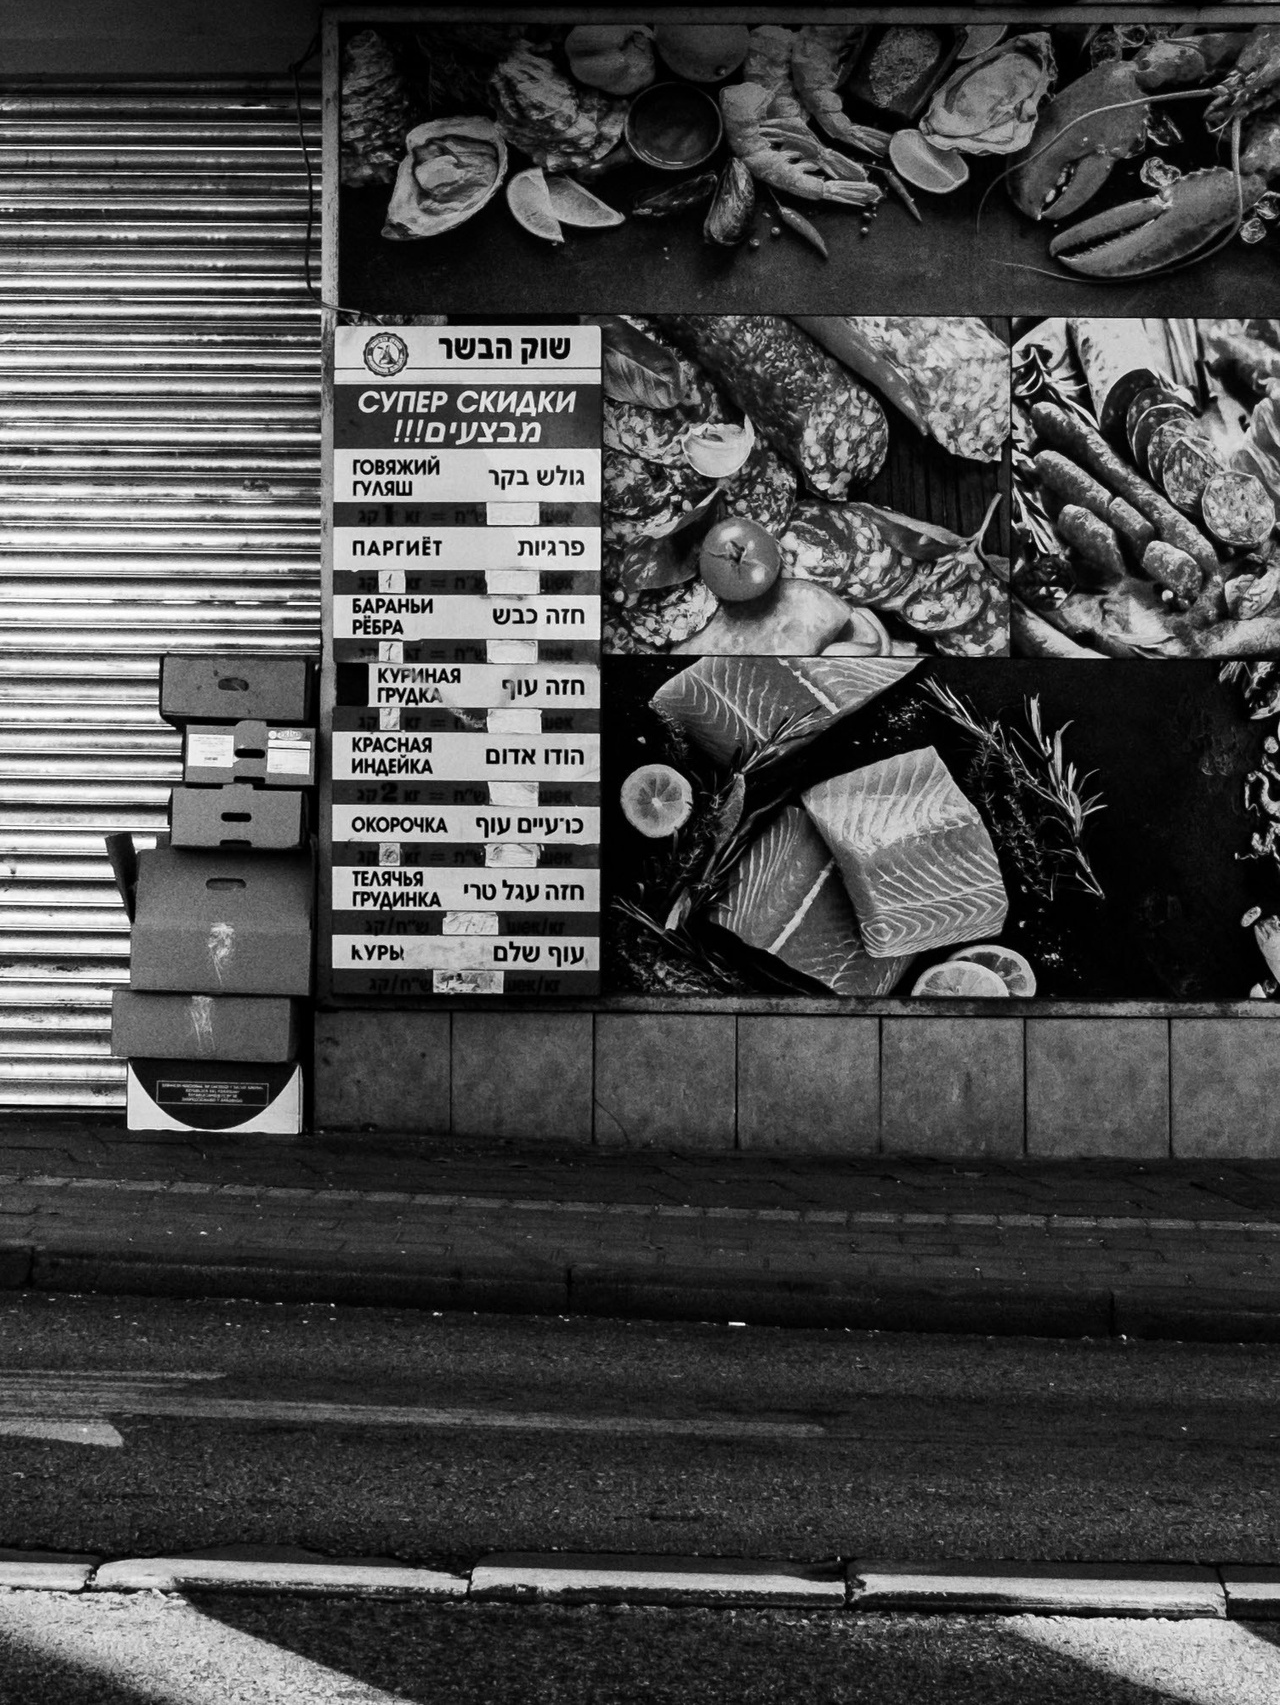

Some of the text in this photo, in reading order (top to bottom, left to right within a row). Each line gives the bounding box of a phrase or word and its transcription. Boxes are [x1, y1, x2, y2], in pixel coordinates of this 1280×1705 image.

[438, 337, 571, 365] שוק הבשר
[358, 390, 577, 417] СУПЕР СКИДКИ
[393, 419, 542, 446] מבצעים!!!
[352, 455, 440, 476] ГОВЯЖИЙ
[488, 464, 585, 491] גולש בקר
[352, 480, 413, 497] ГУЛЯШ
[352, 536, 443, 557] ПАРГИЁТ
[517, 540, 585, 557] פרגיות
[352, 597, 434, 614] БАРАНЬИ
[352, 614, 404, 636] РЁБРА
[492, 608, 585, 626] חזה כבש
[377, 667, 461, 684] КУРИНАЯ
[377, 686, 443, 706] ГРУДКА
[501, 679, 585, 701] חזה עוף
[352, 736, 433, 754] КРАСНАЯ
[351, 754, 434, 777] ИНДЕЙКА
[485, 748, 585, 766] הודו אדום
[351, 816, 449, 834] ОКОРОЧКА
[475, 816, 511, 839] עוף
[351, 870, 424, 887] ТЕЛЯЧЬЯ
[352, 890, 442, 912] ГРУДИНКА
[463, 879, 585, 903] חזה עגל טרי
[493, 940, 585, 968] עוף שלם
